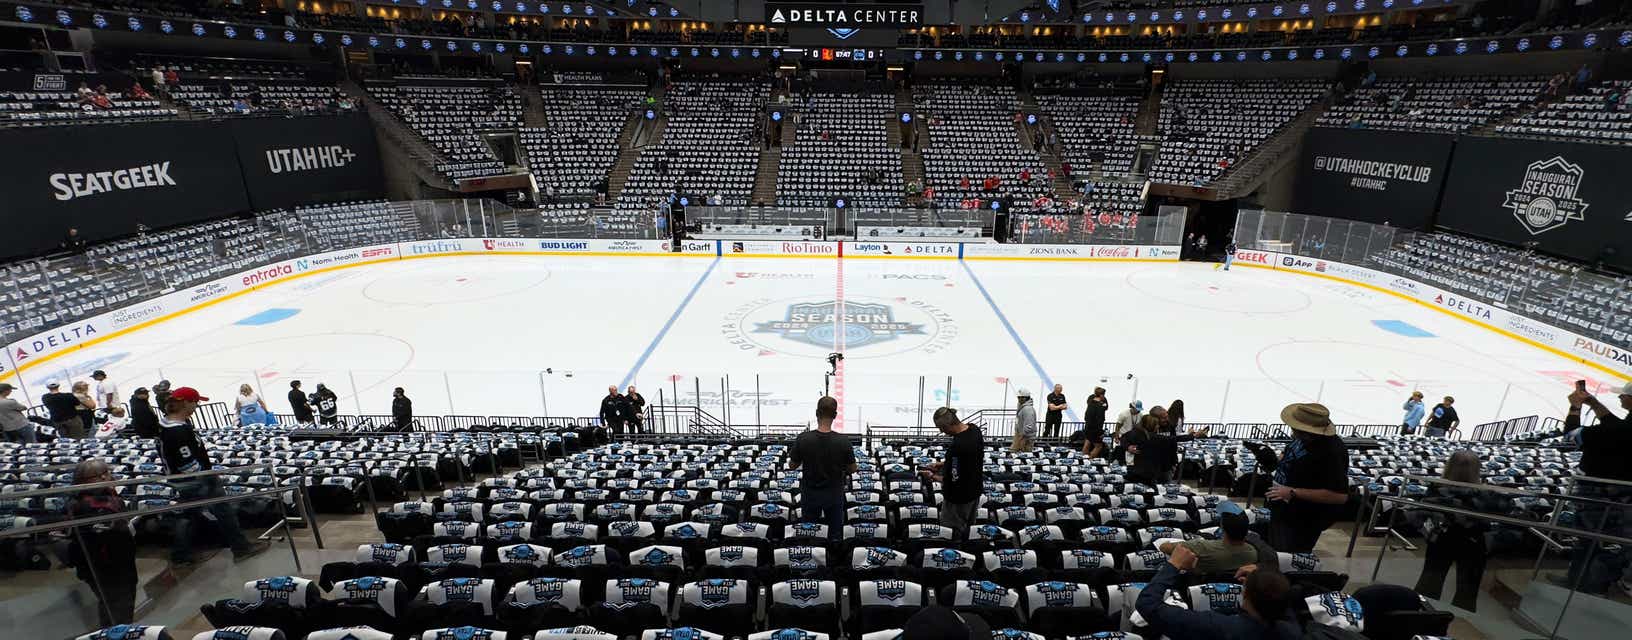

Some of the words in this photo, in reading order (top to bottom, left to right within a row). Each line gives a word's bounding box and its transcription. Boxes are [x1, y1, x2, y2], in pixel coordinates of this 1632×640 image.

[790, 10, 847, 22] DELTA
[854, 10, 918, 23] CENTER
[36, 76, 44, 88] 5
[266, 149, 318, 174] UTAH
[322, 145, 356, 169] HC+
[1314, 156, 1432, 183] @UTAHHOCKEYCLUB
[49, 161, 177, 201] SEATGEEK
[1350, 177, 1386, 191] #UTAHHC
[1528, 170, 1576, 186] INAUGURAL
[1524, 180, 1574, 200] SEASON
[1530, 206, 1552, 218] UTAH
[561, 242, 587, 250] LIGHT
[854, 244, 880, 252] Layton
[362, 248, 392, 258] ESPN
[242, 263, 292, 286] entrata
[1448, 298, 1492, 320] DELTA
[792, 314, 889, 323] SEASON
[32, 324, 96, 352] DELTA
[320, 398, 334, 410] 66
[180, 446, 192, 458] 9
[374, 547, 396, 557] GAME
[443, 546, 466, 555] GAME
[447, 585, 473, 594] GAME
[535, 582, 562, 592] GAME
[624, 586, 650, 595] GAME
[703, 586, 729, 595] GAME
[791, 580, 818, 590] GAME
[878, 580, 905, 590] GAME
[351, 590, 377, 599] GAME
[974, 590, 1000, 602] GAME
[1047, 590, 1073, 600] GAME
